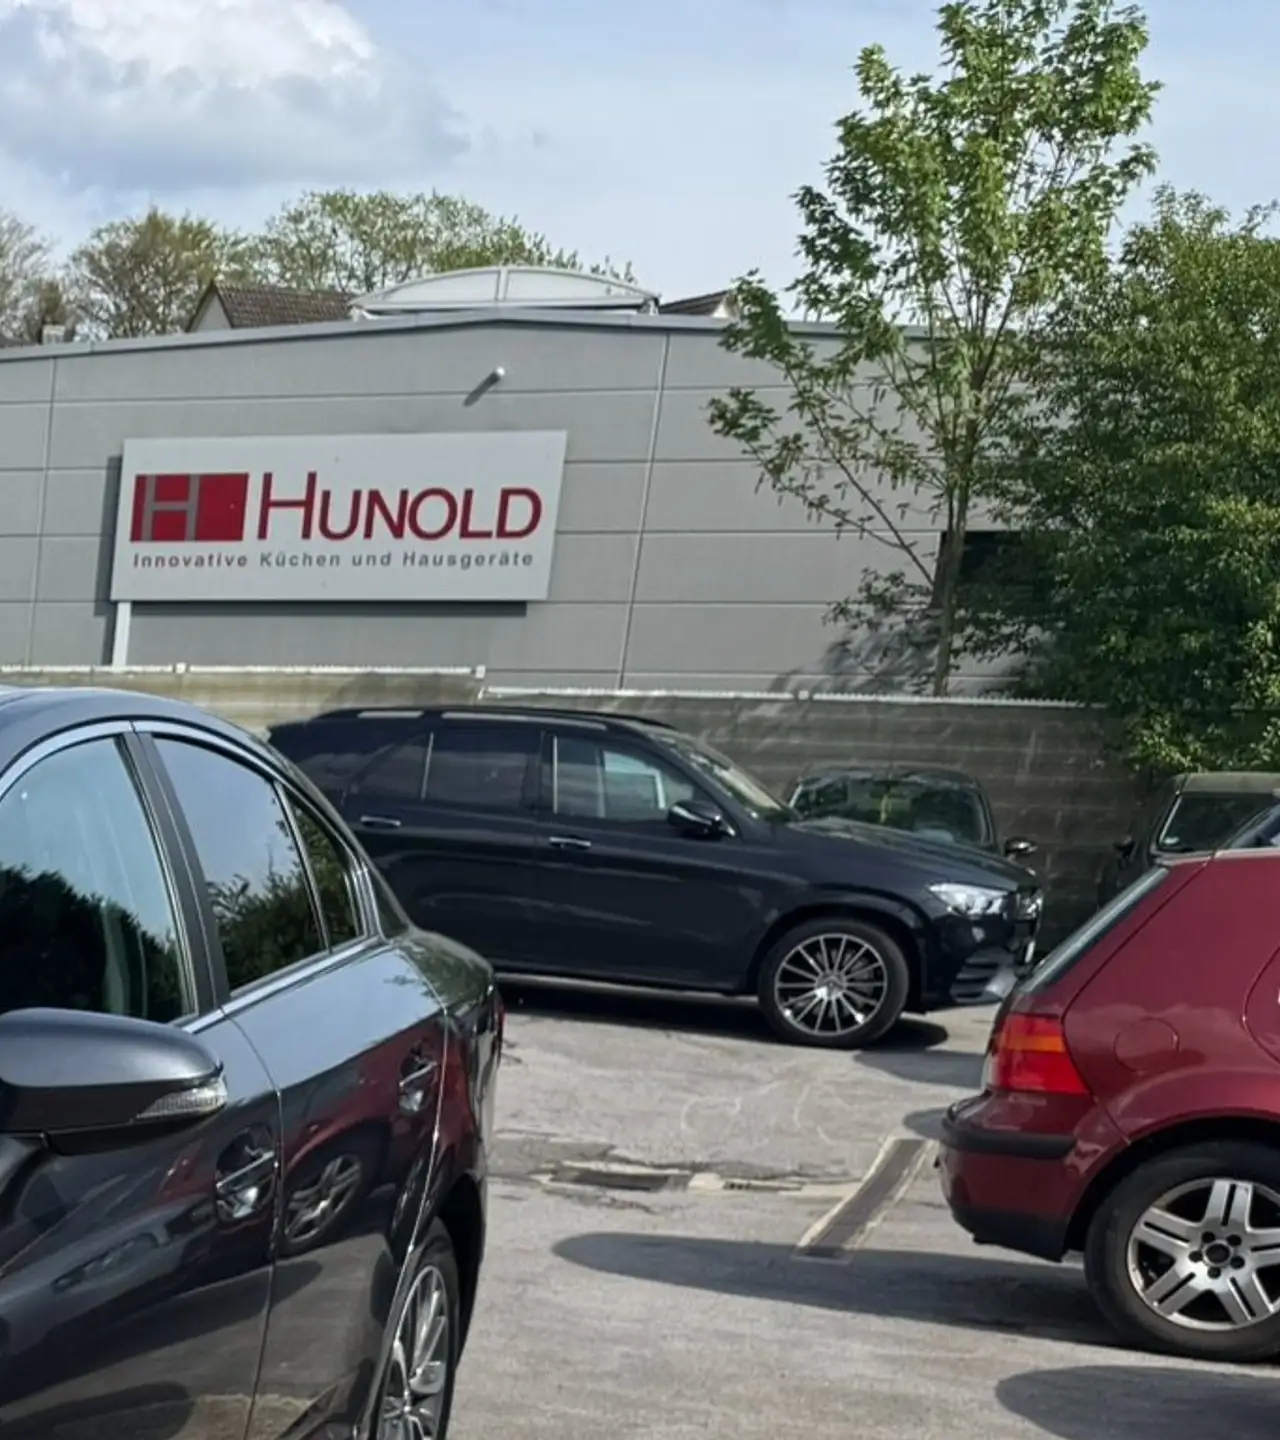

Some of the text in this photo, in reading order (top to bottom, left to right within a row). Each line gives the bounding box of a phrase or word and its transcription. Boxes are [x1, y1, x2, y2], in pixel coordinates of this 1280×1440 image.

[256, 471, 544, 541] HUNOLD
[133, 550, 534, 570] Innovative Küchen und Hausgeräte
